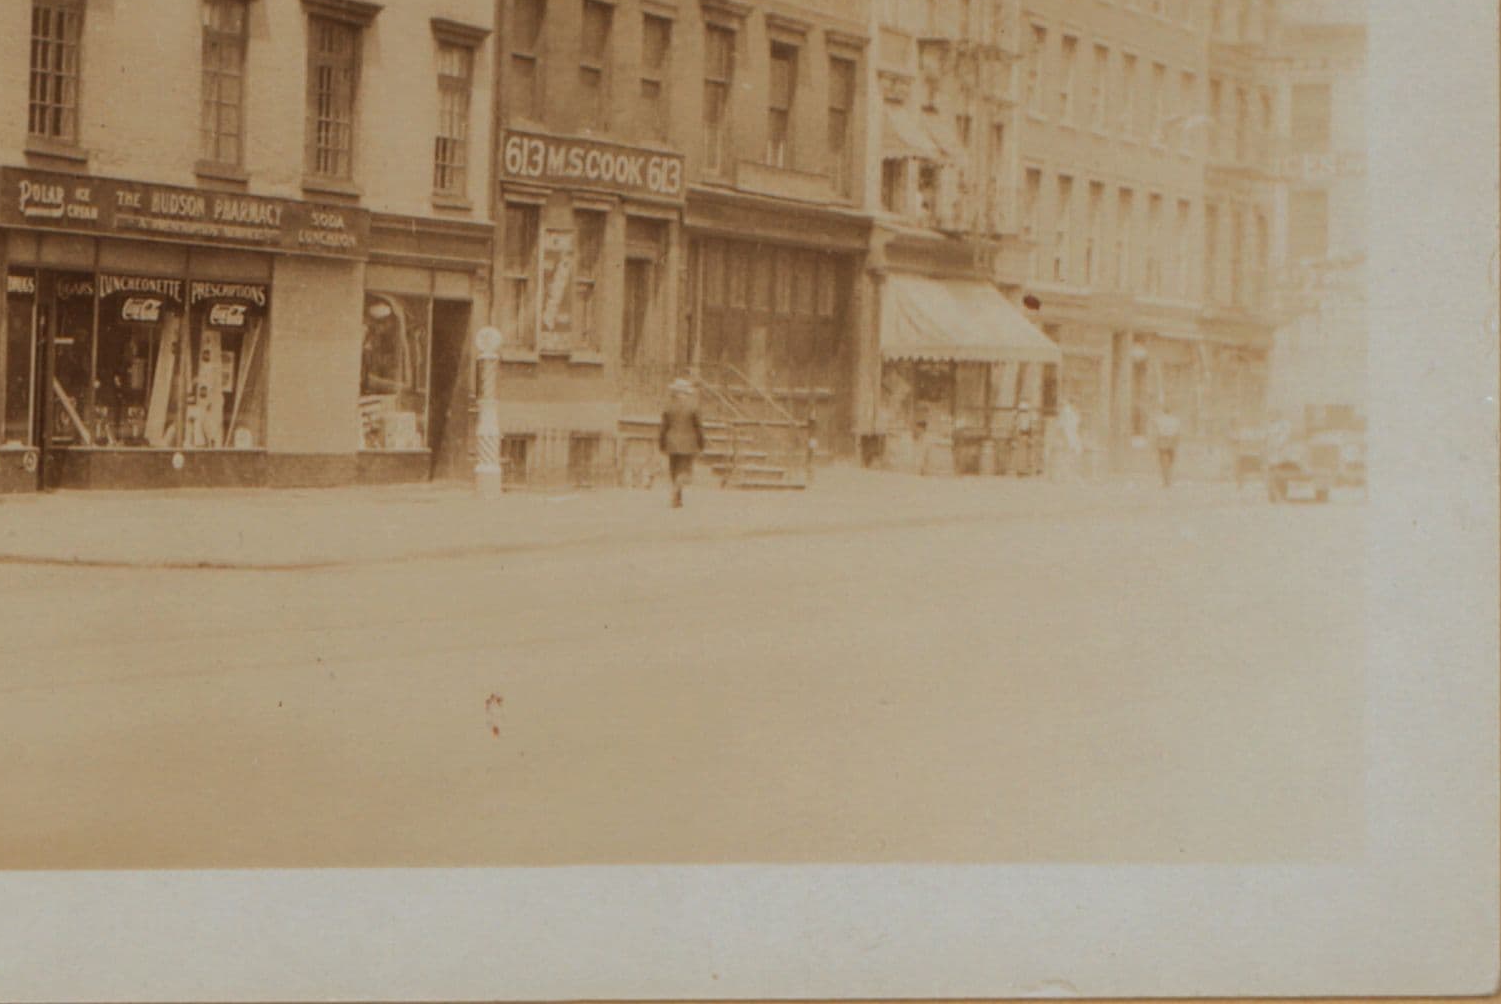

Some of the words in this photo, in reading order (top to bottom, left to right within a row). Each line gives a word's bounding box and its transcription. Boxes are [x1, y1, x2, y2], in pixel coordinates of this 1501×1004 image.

[505, 136, 545, 176] 613
[648, 157, 681, 194] 613
[19, 180, 66, 218] POLAR
[116, 190, 141, 207] THE
[151, 192, 205, 217] HUDSON
[214, 199, 283, 226] PHARMACY
[311, 212, 345, 229] SODA
[99, 275, 182, 302] LUNCHEONETTE
[191, 282, 266, 306] PRESCRIPTIONS
